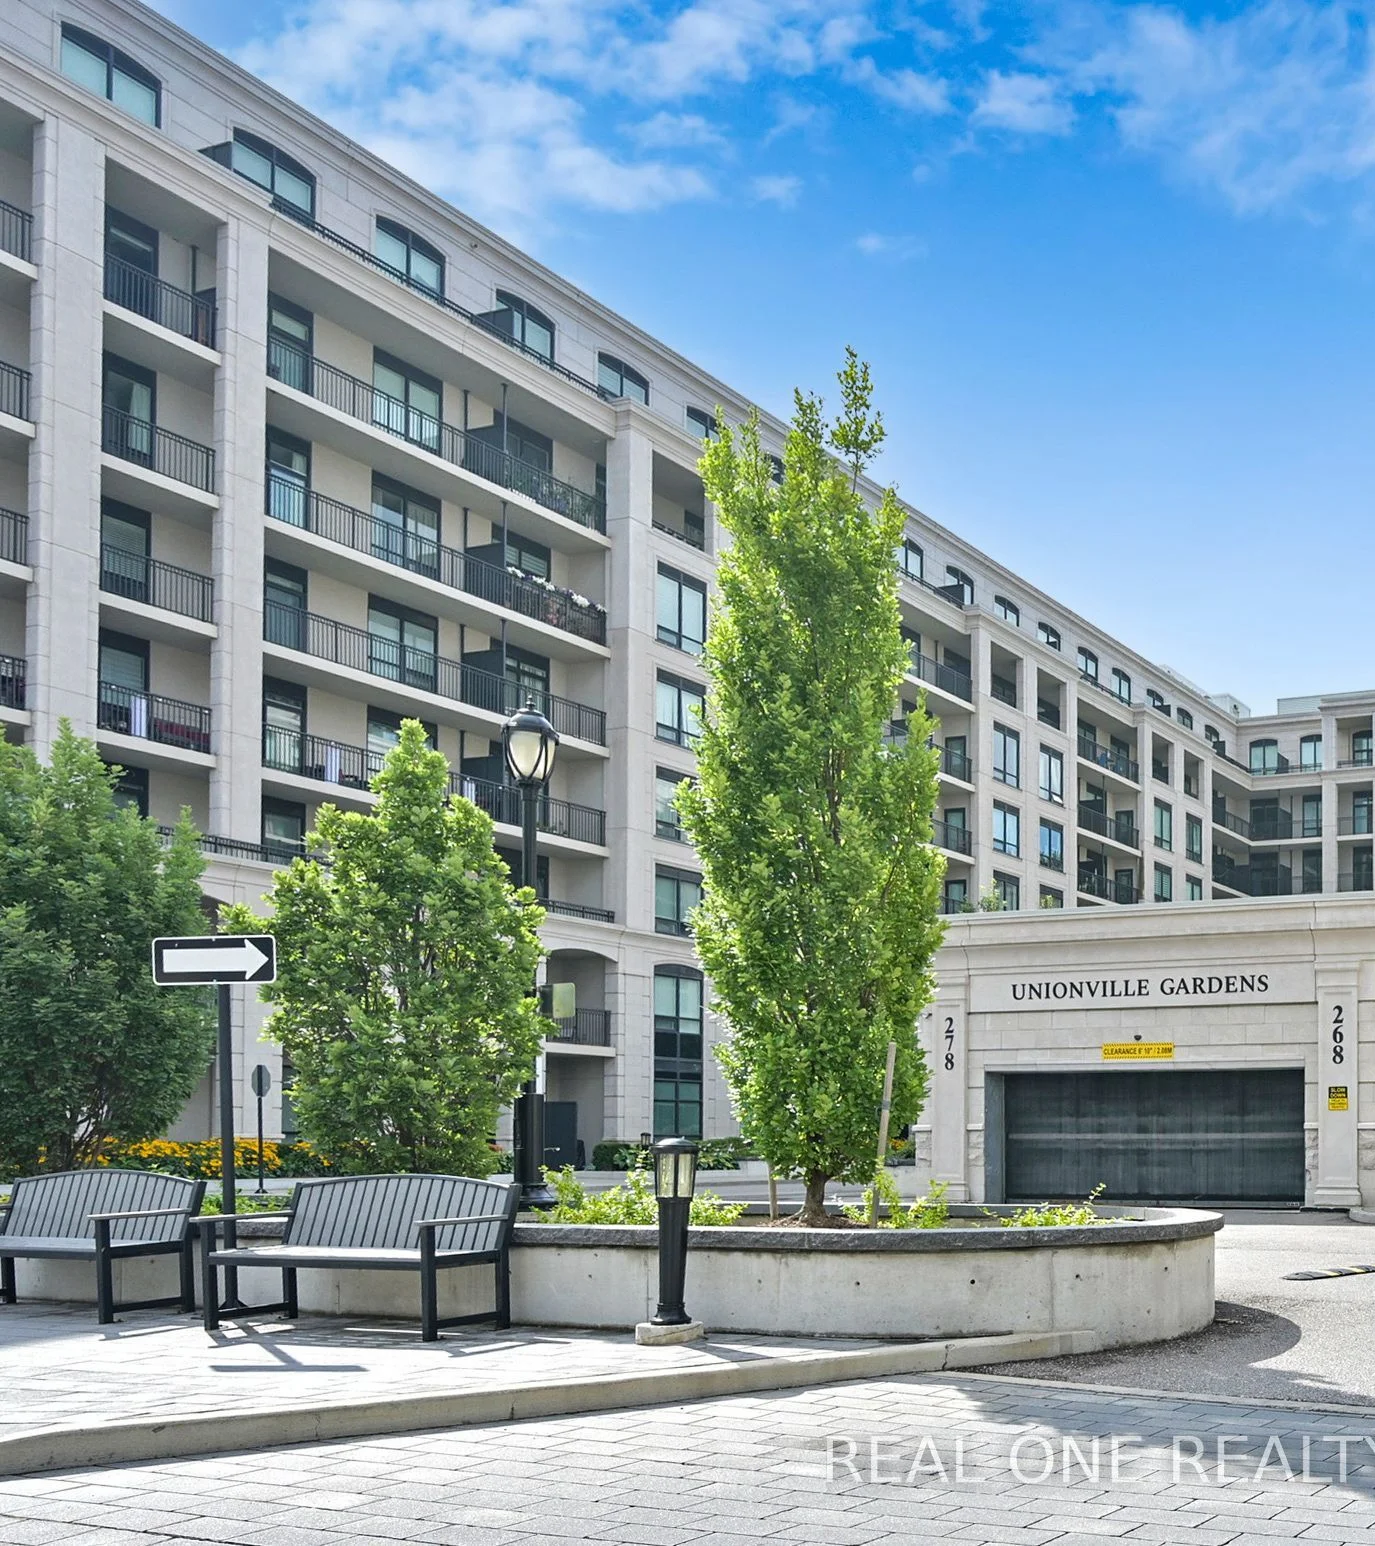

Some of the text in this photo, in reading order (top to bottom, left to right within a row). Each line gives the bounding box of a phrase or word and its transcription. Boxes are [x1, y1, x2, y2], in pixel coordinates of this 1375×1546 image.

[1011, 974, 1269, 1001] UNIONVILLE GARDENS
[944, 1016, 955, 1071] 278
[1103, 1047, 1137, 1055] CLEARANCE
[1332, 1005, 1344, 1064] 268
